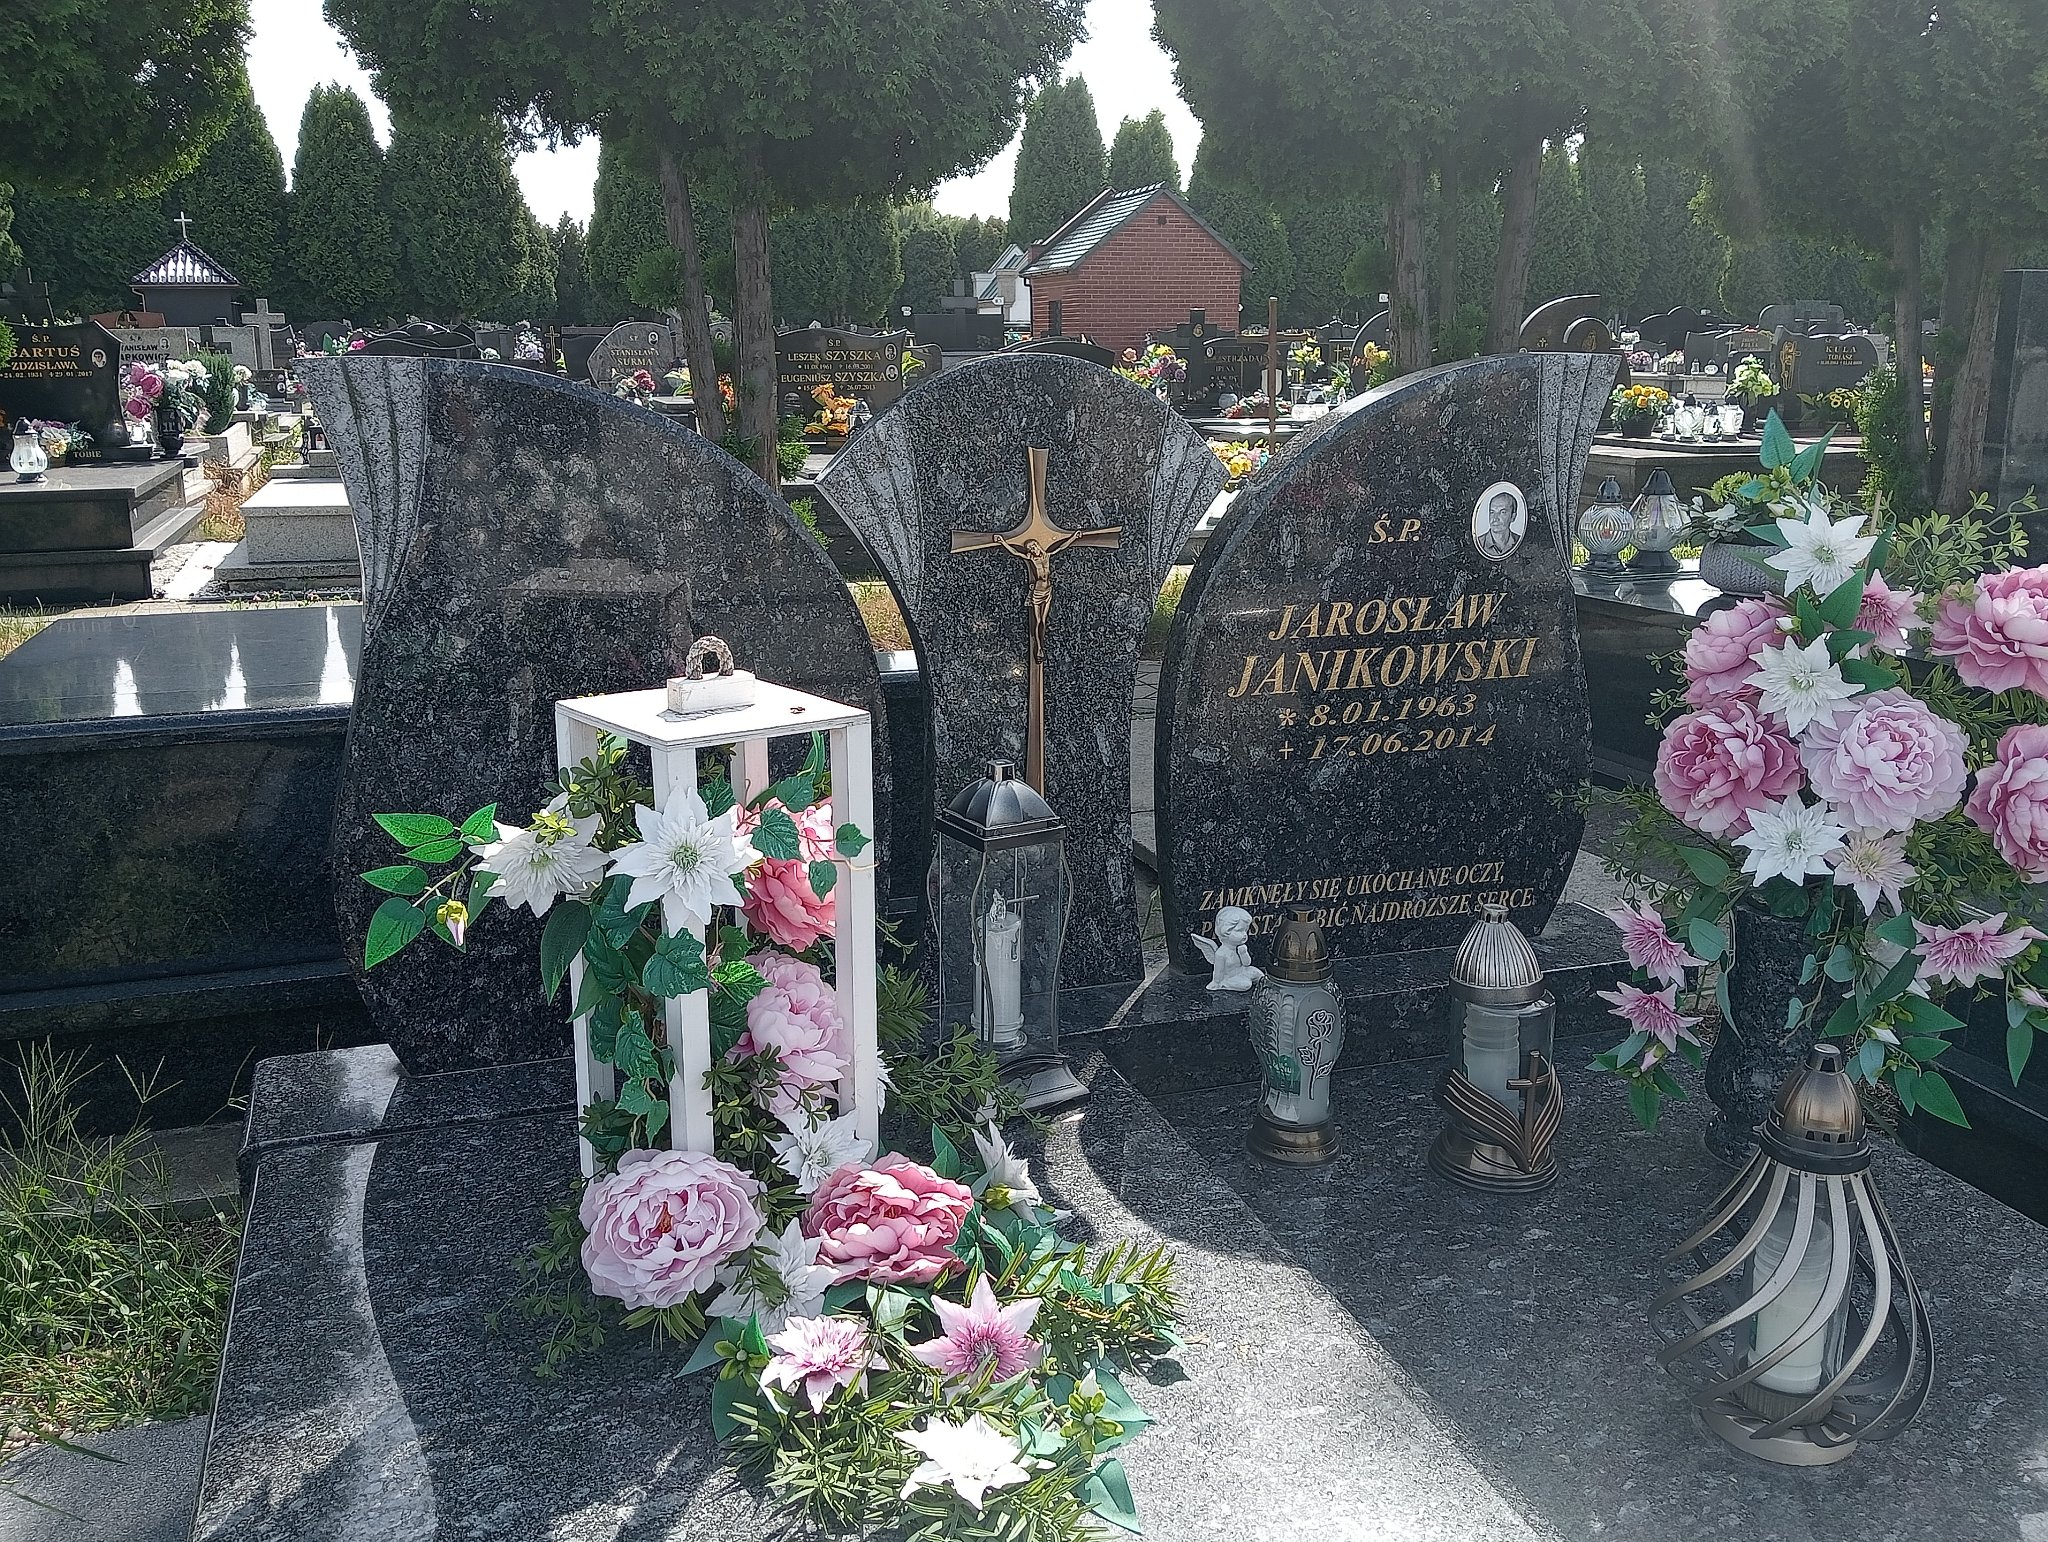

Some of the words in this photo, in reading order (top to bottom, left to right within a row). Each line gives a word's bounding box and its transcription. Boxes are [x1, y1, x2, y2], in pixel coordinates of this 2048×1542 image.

[8, 345, 81, 358] BARTUŚ
[617, 358, 653, 366] SURMA
[788, 353, 821, 361] LESZEK
[825, 351, 881, 361] SZYSZKA
[781, 374, 831, 383] EUGENIUSZ
[834, 372, 887, 382] SZYSZKA
[1368, 513, 1421, 544] Ś.P.
[1268, 592, 1508, 641] JAROSŁAW
[1227, 636, 1540, 698] JANIKOWSKI
[1308, 693, 1477, 726] 8.01.1963
[1307, 723, 1497, 760] 17.06.2014
[1199, 880, 1308, 911] ZAMKNĘŁY
[1310, 877, 1342, 902] SIĘ
[1346, 867, 1453, 897] UKOCHANE
[1316, 901, 1350, 928] BIĆ
